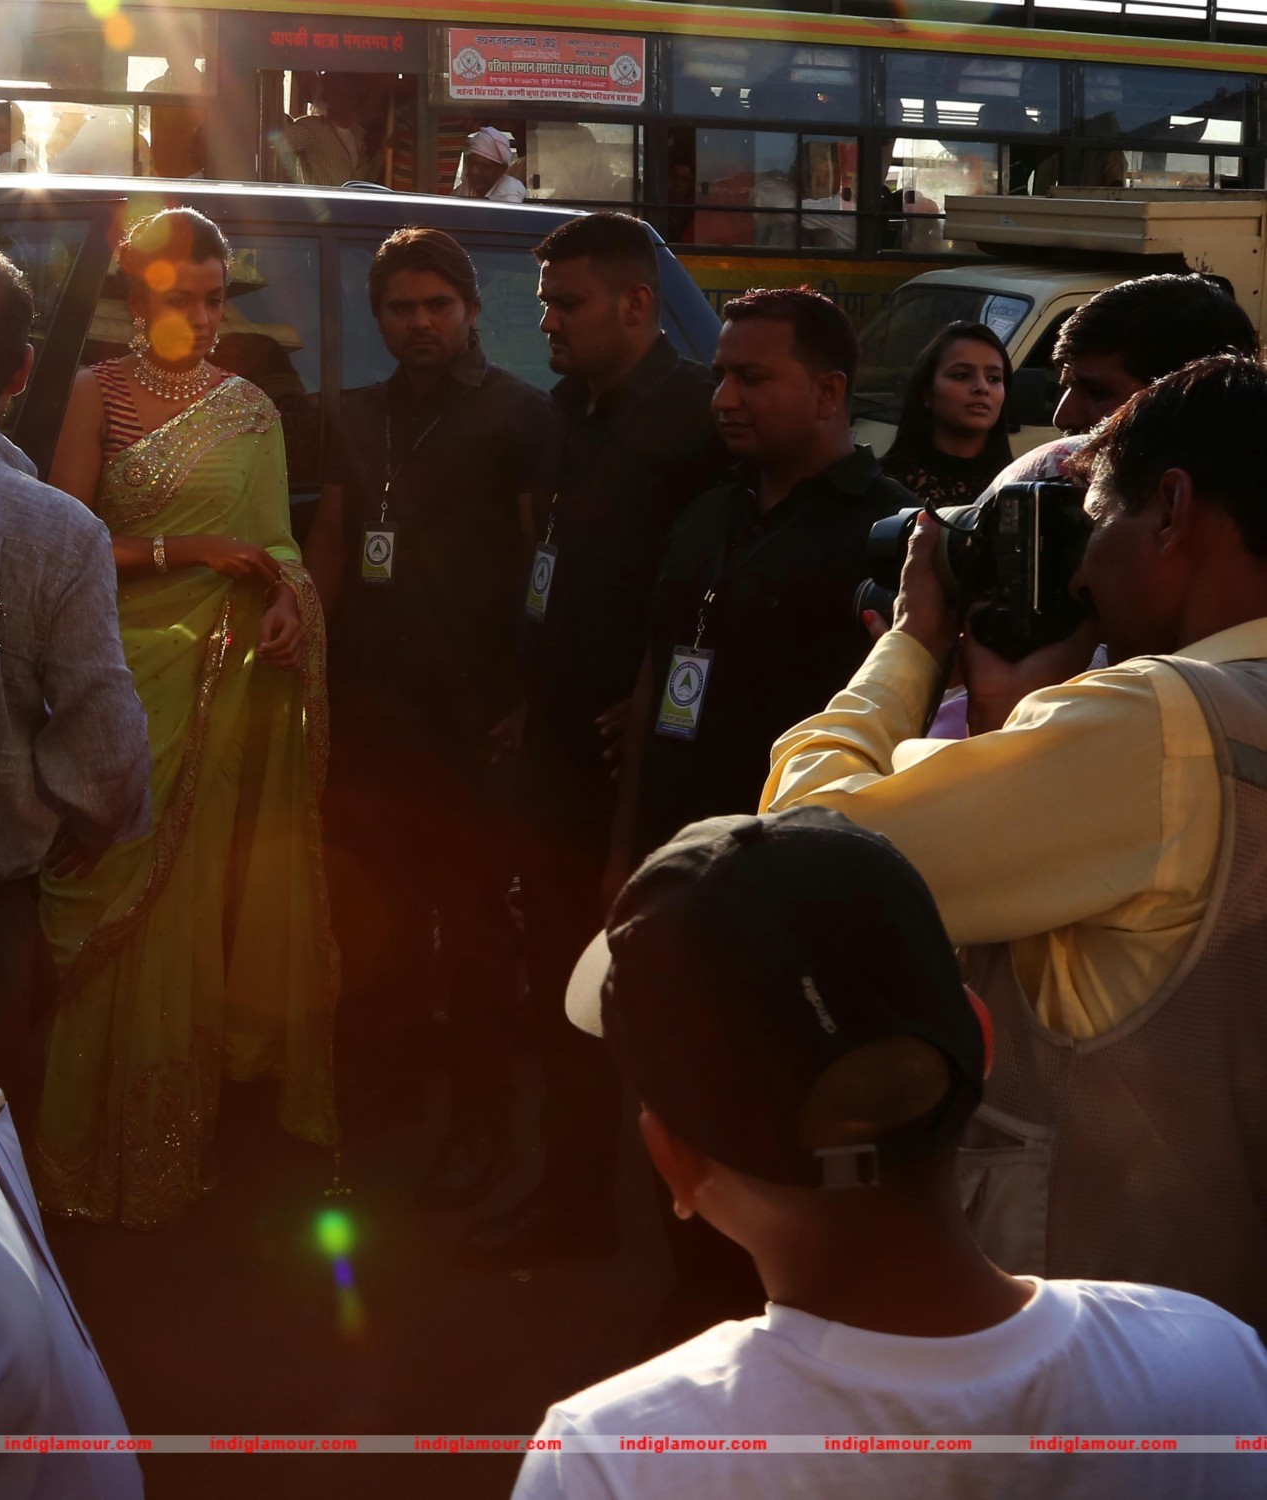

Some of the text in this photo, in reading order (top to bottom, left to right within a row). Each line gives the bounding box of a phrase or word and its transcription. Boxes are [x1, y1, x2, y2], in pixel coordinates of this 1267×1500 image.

[269, 26, 404, 52] आपकी यात्रा मंगलमय हो
[487, 58, 510, 73] प्रतिभा
[511, 61, 534, 73] सम्मान
[535, 61, 562, 75] समारोह
[591, 64, 608, 77] यात्रा
